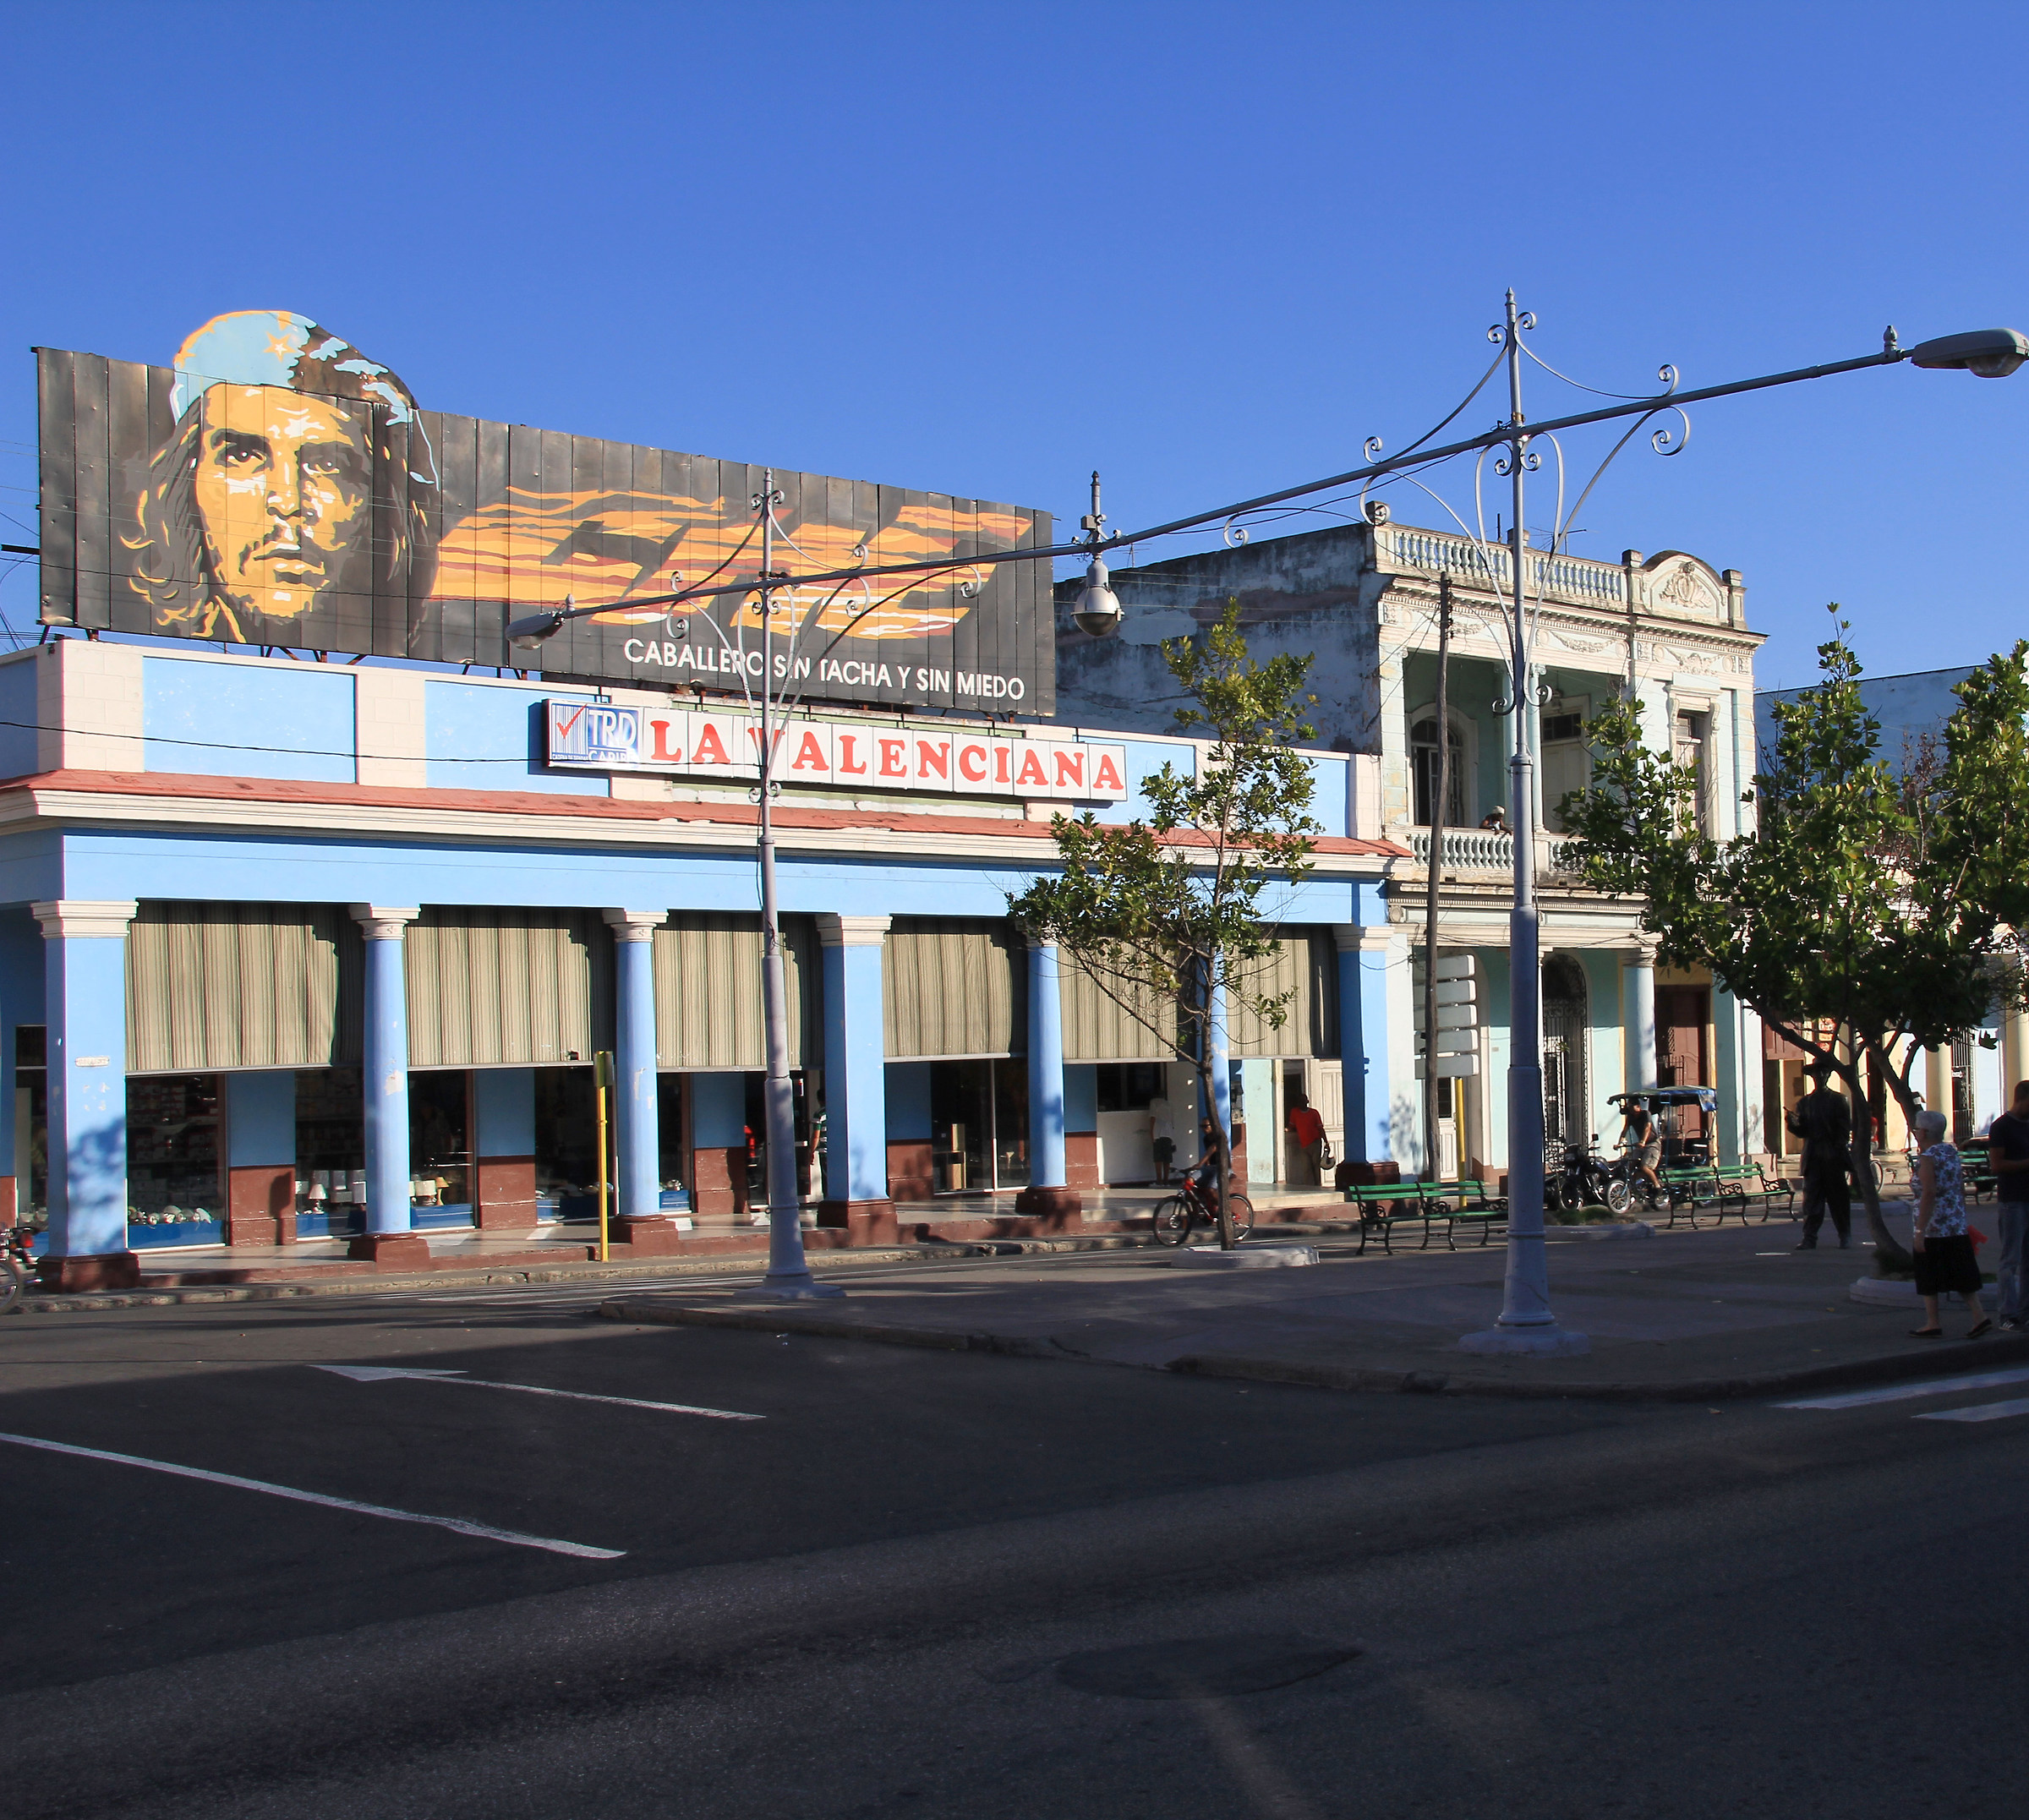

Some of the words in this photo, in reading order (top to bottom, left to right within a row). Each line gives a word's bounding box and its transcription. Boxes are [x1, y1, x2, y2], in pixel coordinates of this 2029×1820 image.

[774, 654, 811, 680] SN
[819, 658, 893, 688] TACHA
[897, 665, 911, 690] Y
[916, 668, 950, 693] SIN
[957, 670, 1025, 701] MIEDO
[588, 709, 637, 747] TRD
[650, 720, 731, 764] LA
